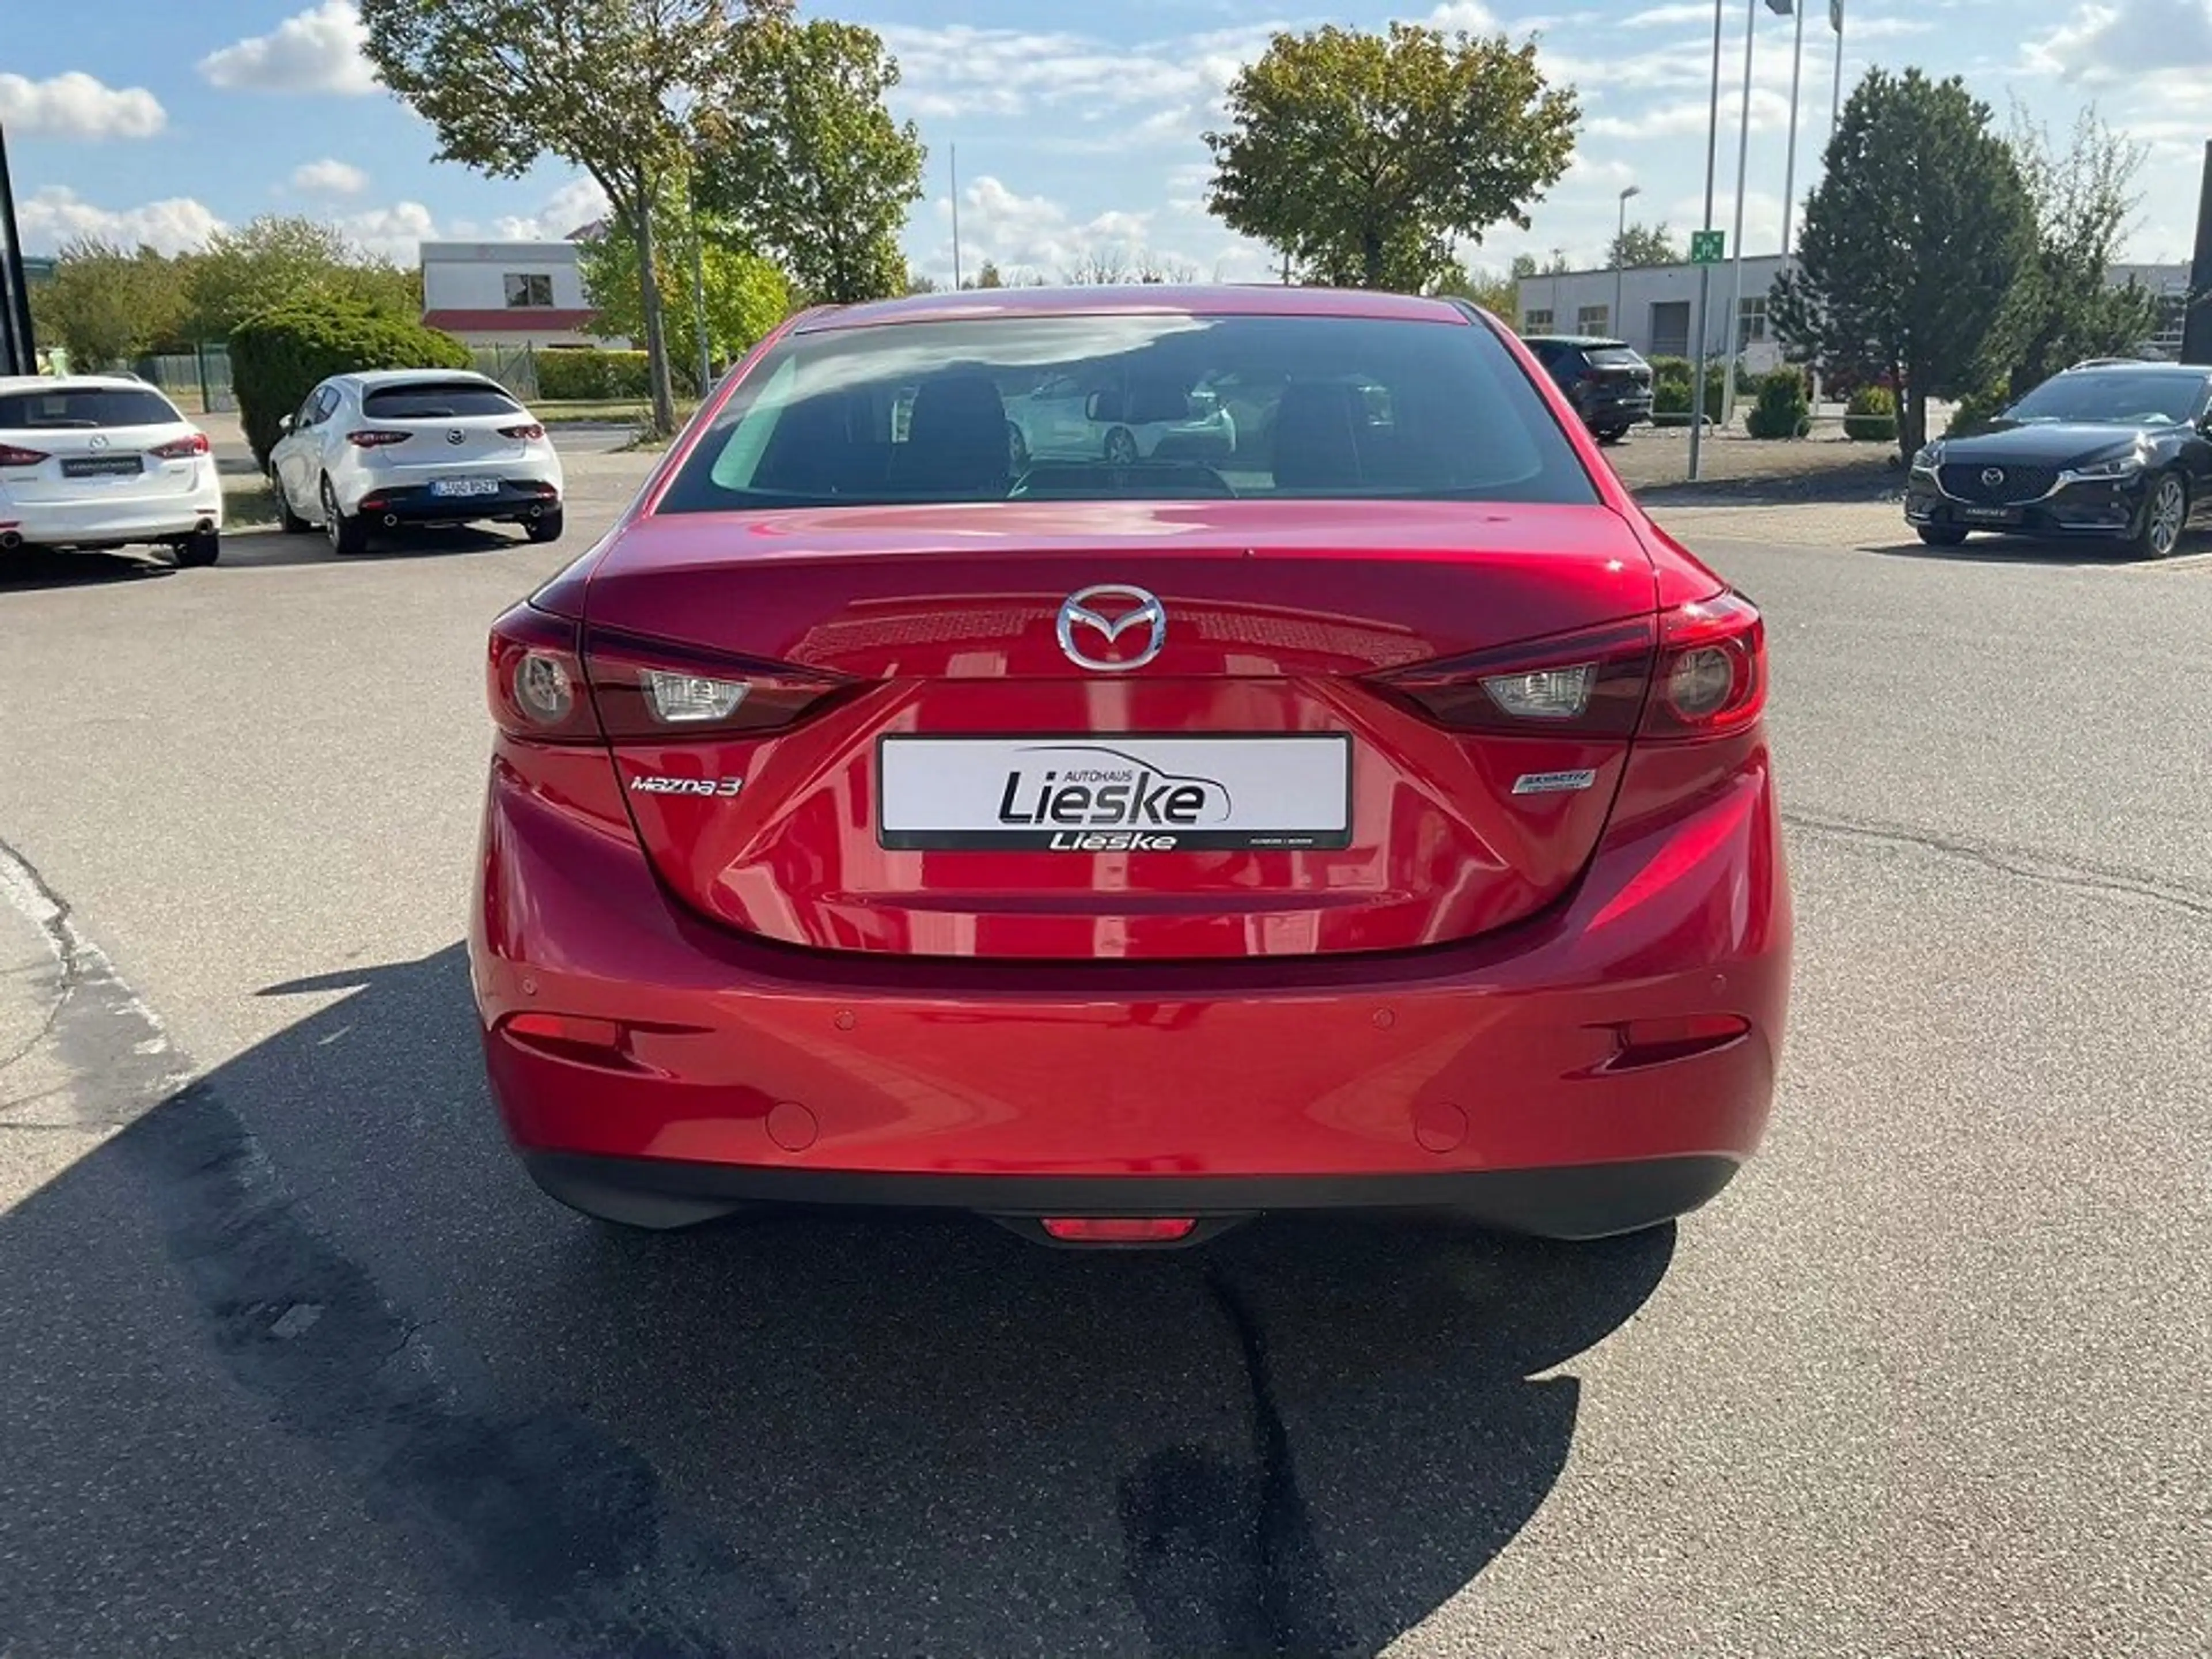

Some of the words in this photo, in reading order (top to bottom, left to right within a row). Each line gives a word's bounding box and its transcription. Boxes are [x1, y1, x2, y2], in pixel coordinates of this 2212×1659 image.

[1063, 770, 1132, 782] AUTOHAUS
[998, 771, 1205, 824] Lieske
[1050, 831, 1177, 851] Lieske
